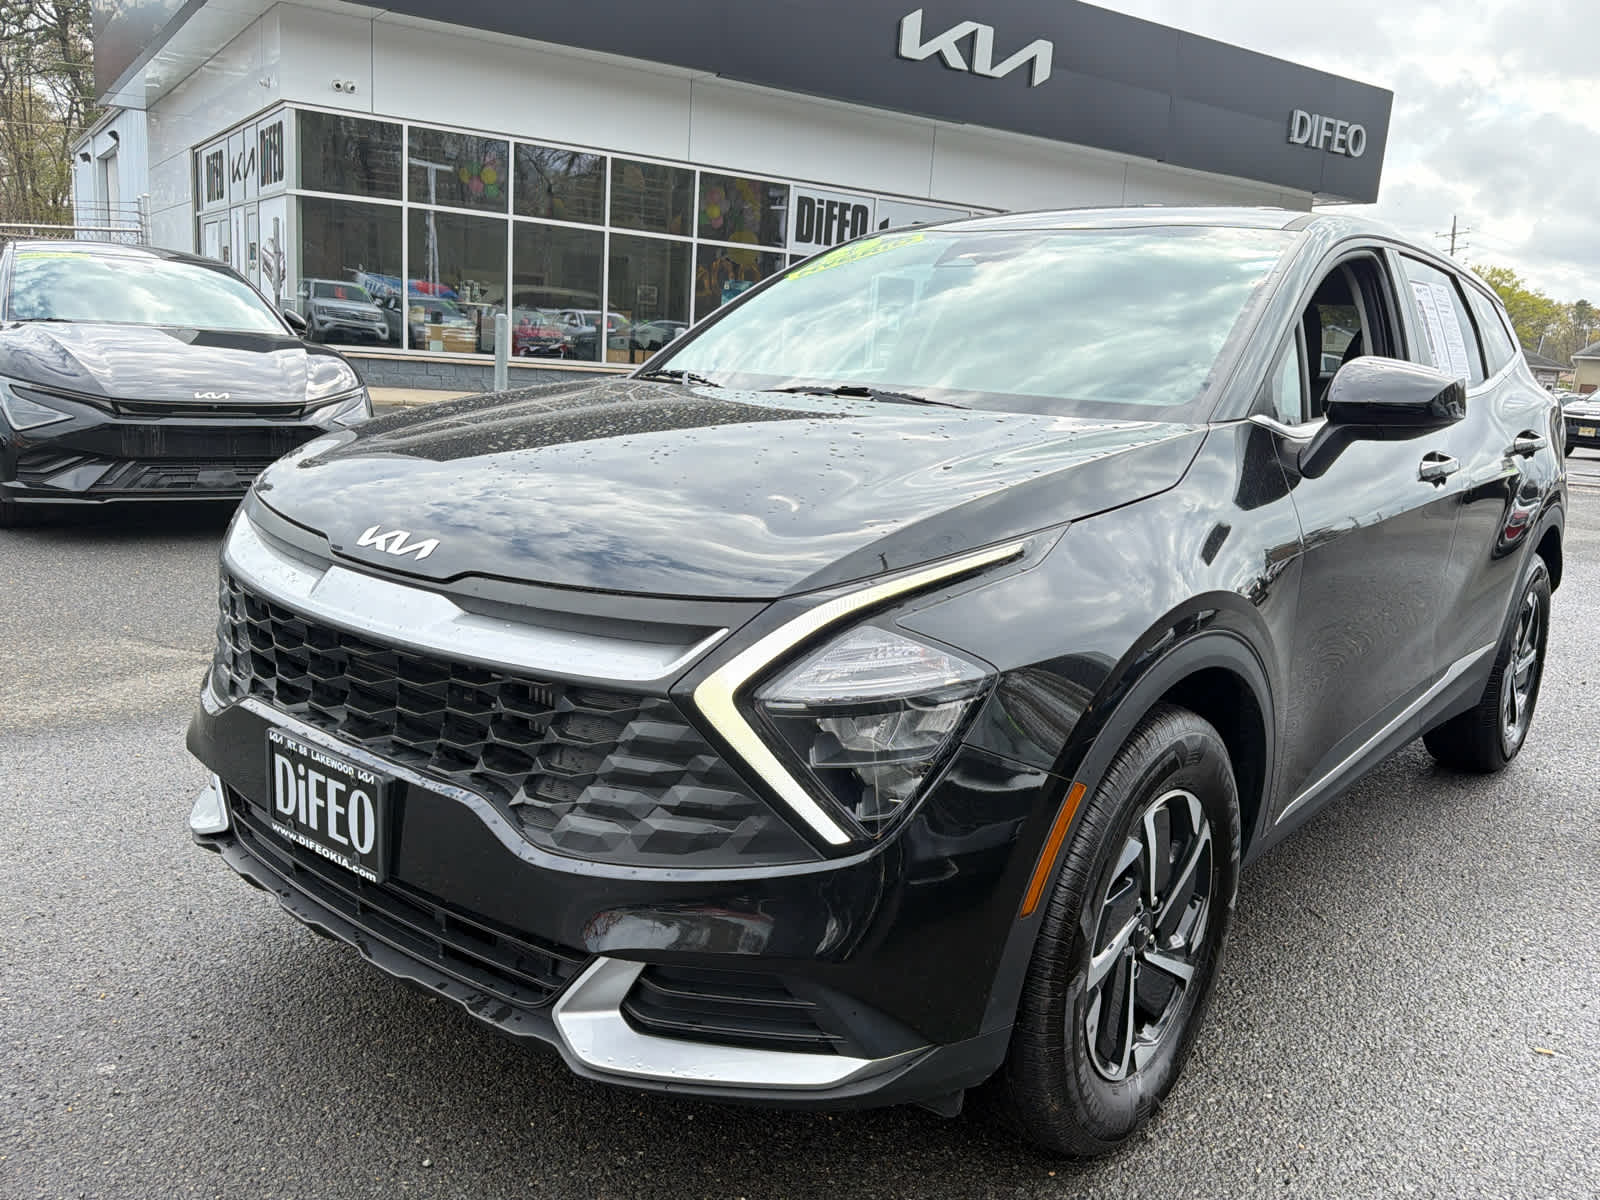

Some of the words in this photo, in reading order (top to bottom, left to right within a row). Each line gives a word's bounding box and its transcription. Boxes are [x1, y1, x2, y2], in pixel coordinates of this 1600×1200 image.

[899, 8, 1053, 88] KIA
[260, 120, 284, 187] DiFEO
[1289, 108, 1367, 157] DIFEO
[194, 391, 230, 400] KIA
[356, 524, 440, 560] KIA
[311, 750, 354, 776] LAKEWOOD
[274, 753, 375, 854] DiFEO
[271, 822, 377, 883] www.DIFEOKIA.com
